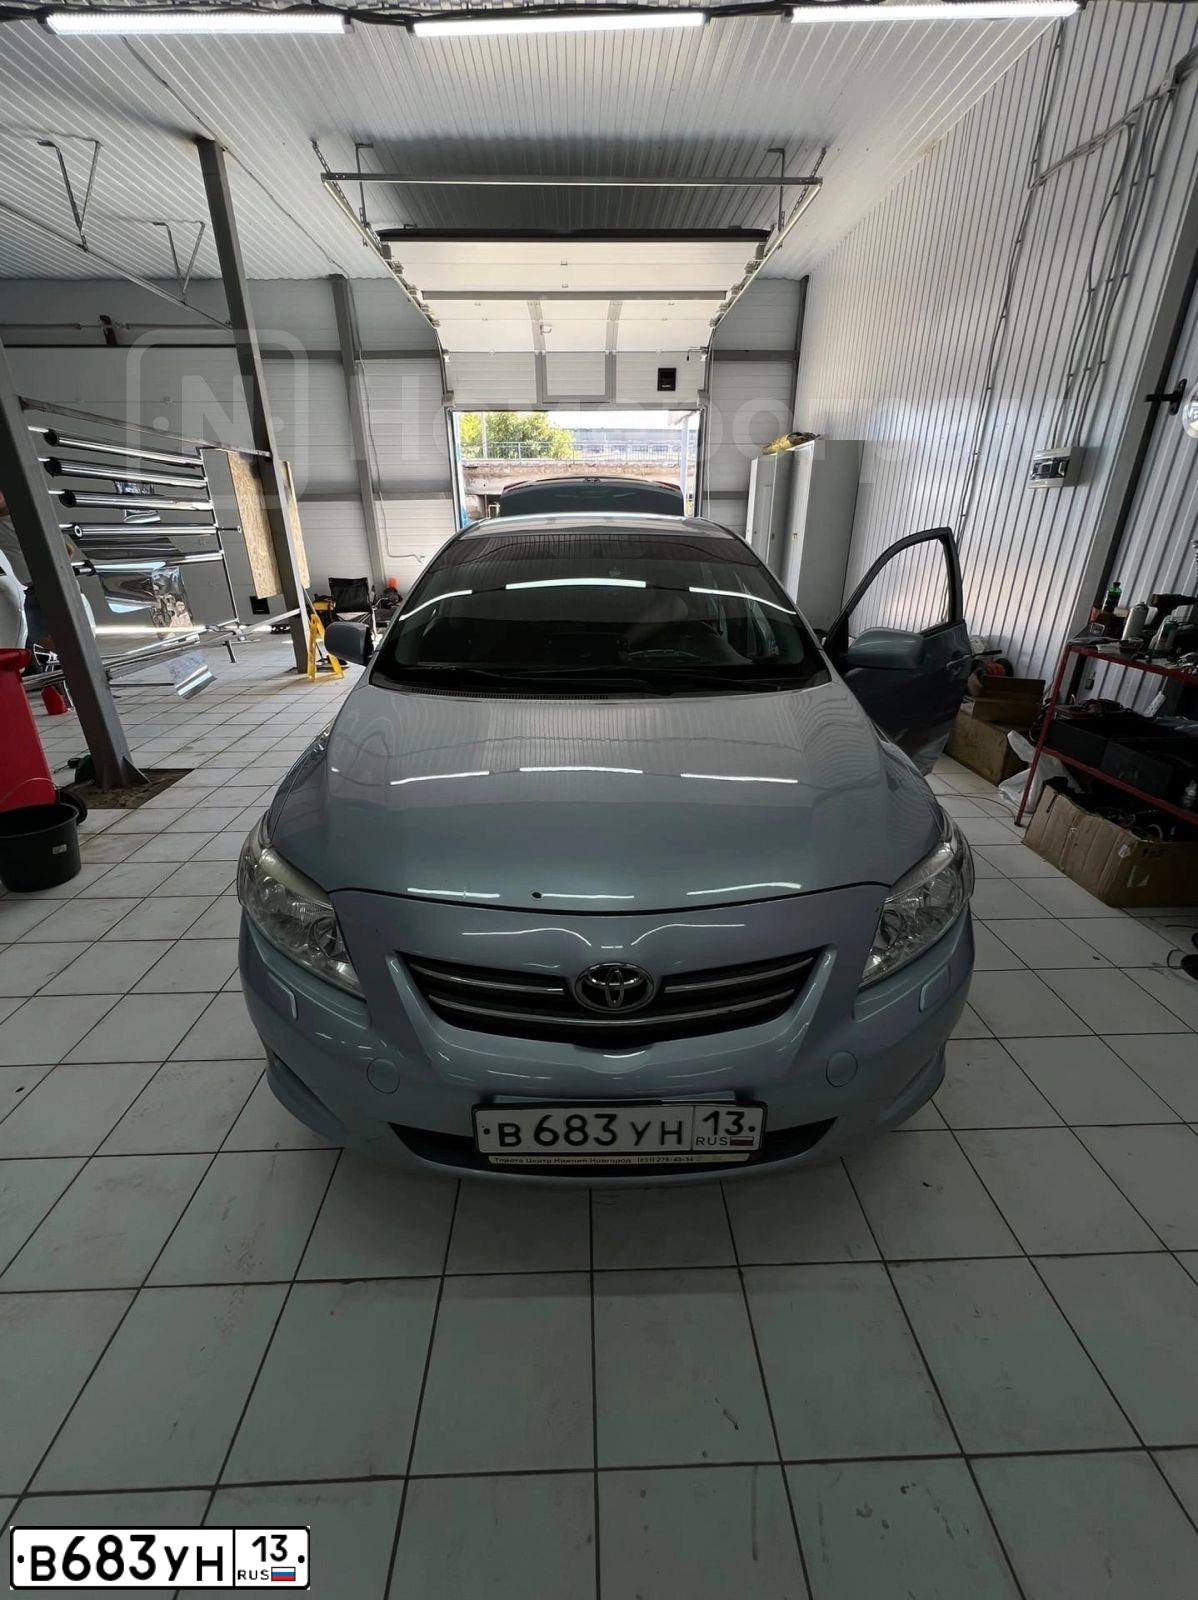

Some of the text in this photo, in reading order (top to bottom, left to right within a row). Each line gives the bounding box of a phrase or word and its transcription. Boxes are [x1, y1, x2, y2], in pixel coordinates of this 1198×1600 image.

[498, 1113, 683, 1147] В683УН
[703, 1110, 745, 1136] 13
[695, 1136, 728, 1147] RUS
